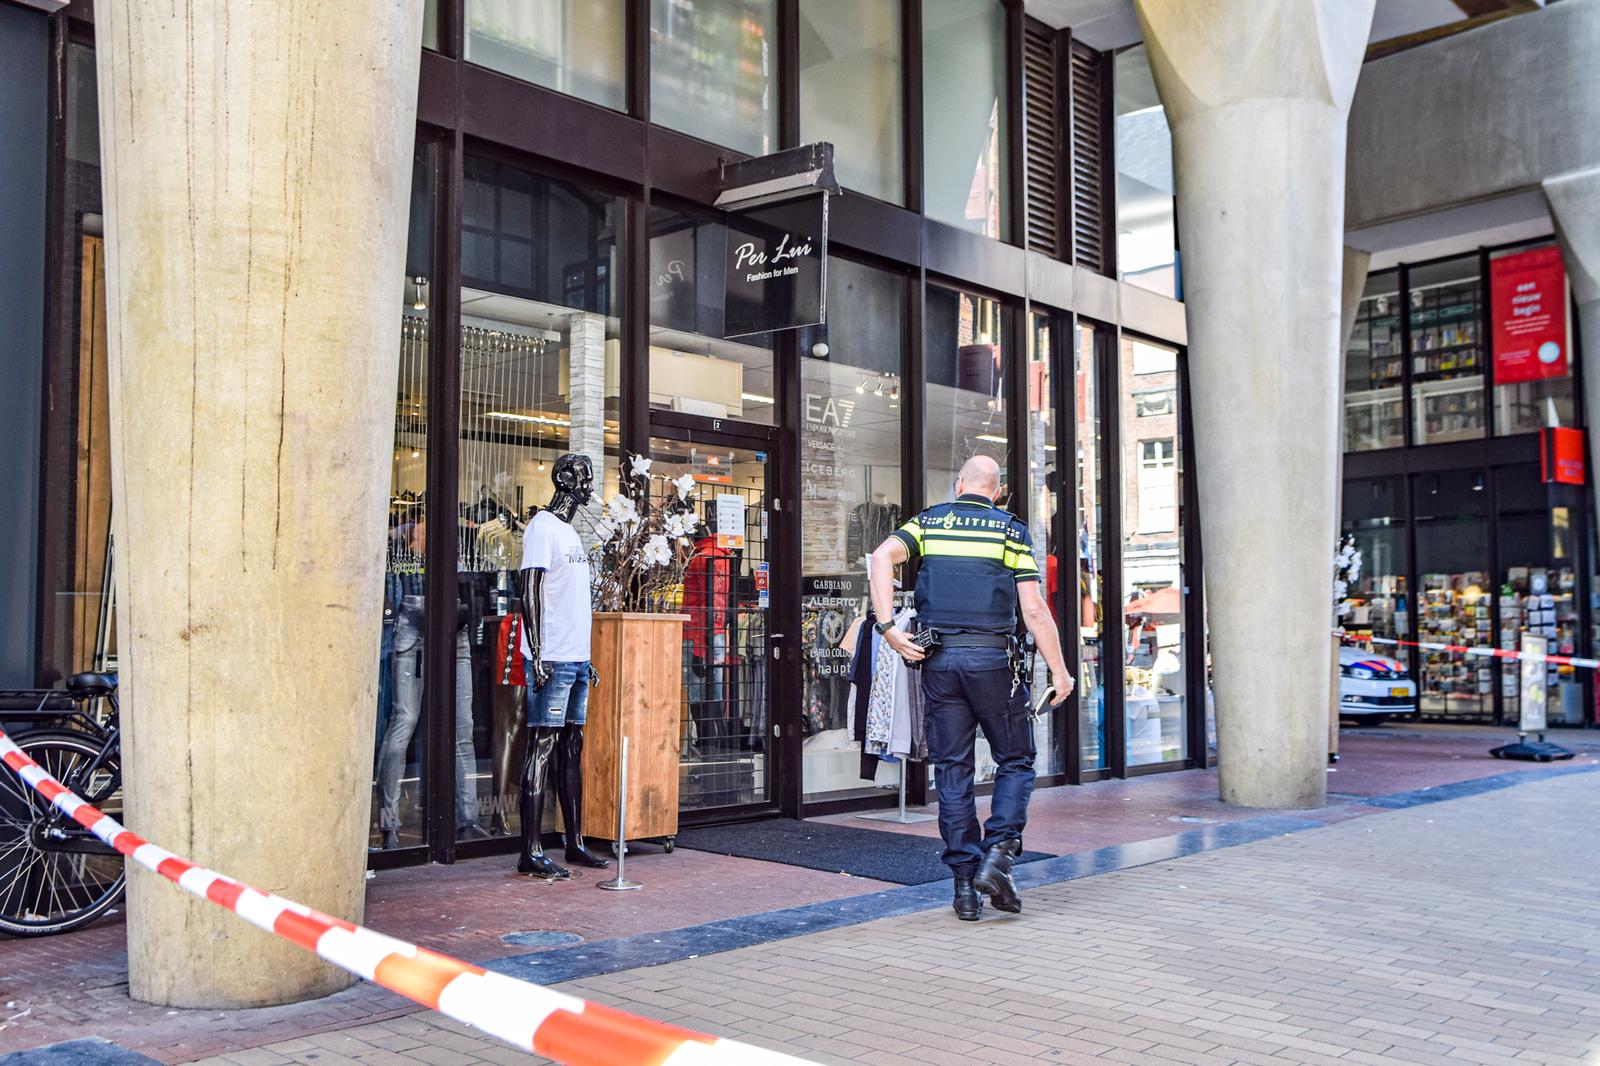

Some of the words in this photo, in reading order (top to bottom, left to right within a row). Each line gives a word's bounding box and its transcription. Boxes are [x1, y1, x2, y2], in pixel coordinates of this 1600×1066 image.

[735, 242, 768, 270] Per
[771, 233, 812, 264] Lui
[746, 271, 773, 282] Fashion
[773, 269, 783, 277] for
[783, 266, 799, 276] Men
[806, 393, 856, 428] EA7
[937, 512, 995, 529] POLITIE
[813, 579, 852, 590] GABBIANO
[809, 597, 856, 607] ALBERTO
[818, 662, 851, 676] haupt
